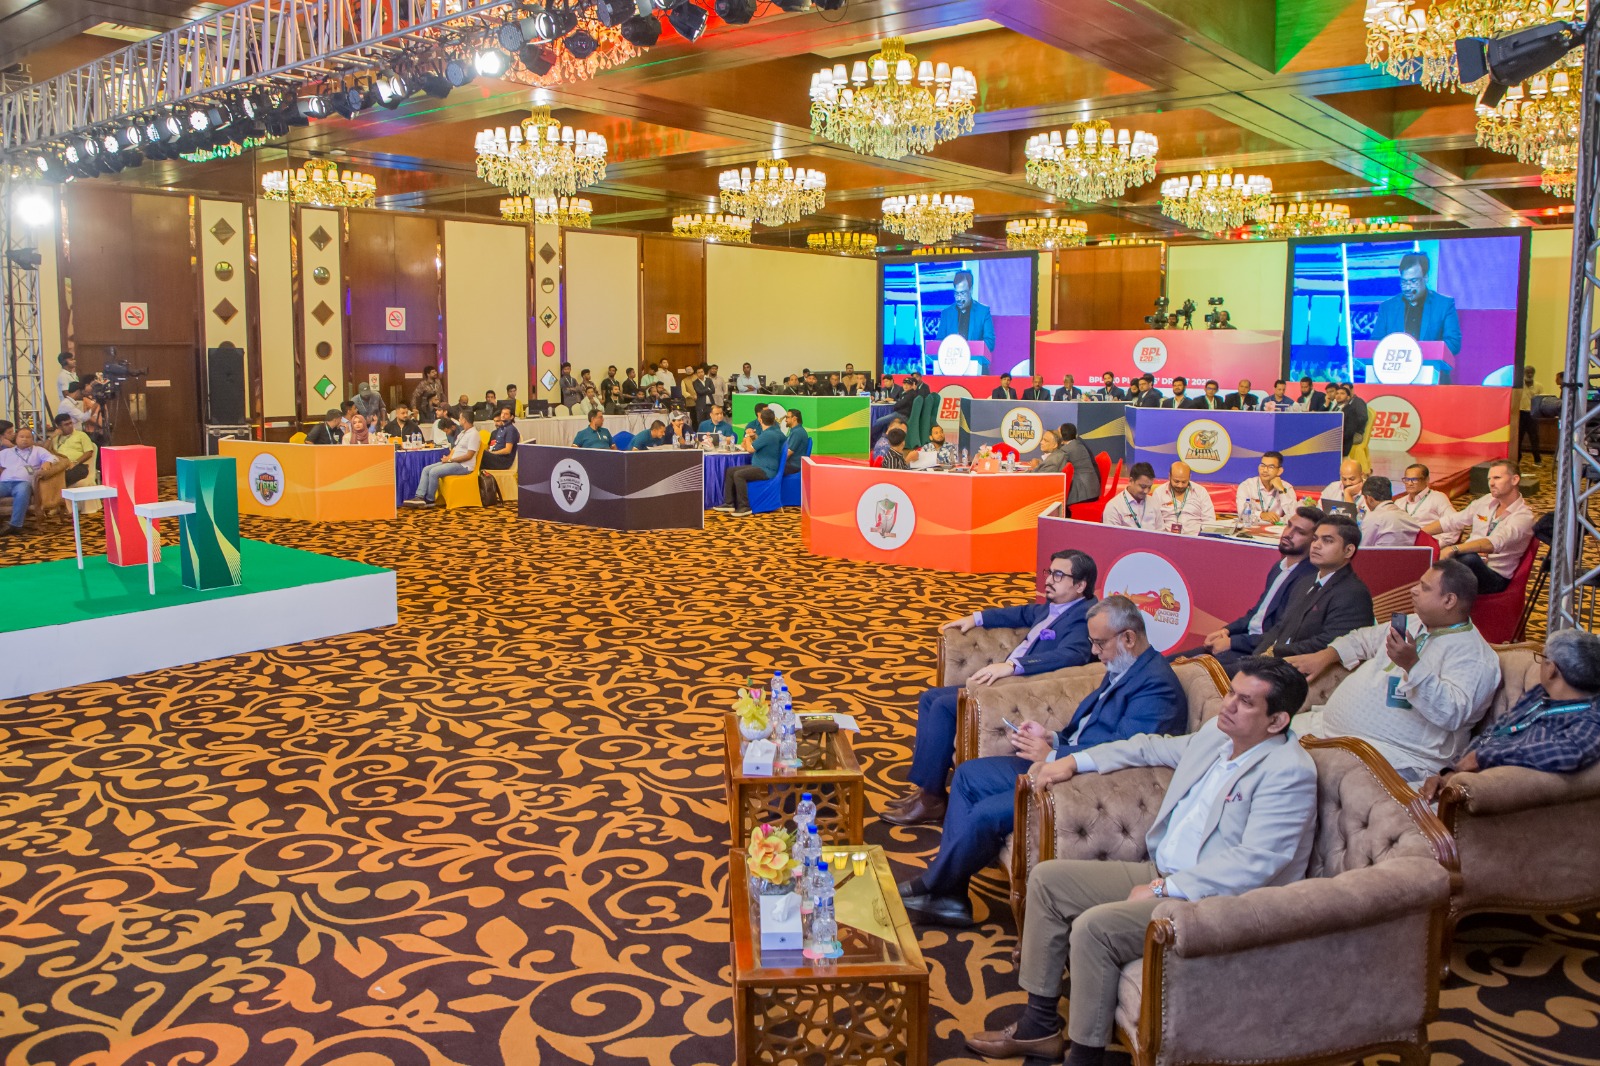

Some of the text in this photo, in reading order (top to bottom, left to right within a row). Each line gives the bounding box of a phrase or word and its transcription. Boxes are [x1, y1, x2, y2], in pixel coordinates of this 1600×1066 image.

[1141, 347, 1161, 356] BPL
[1385, 349, 1412, 362] BPL
[942, 397, 960, 410] BP
[1374, 412, 1411, 428] BPL
